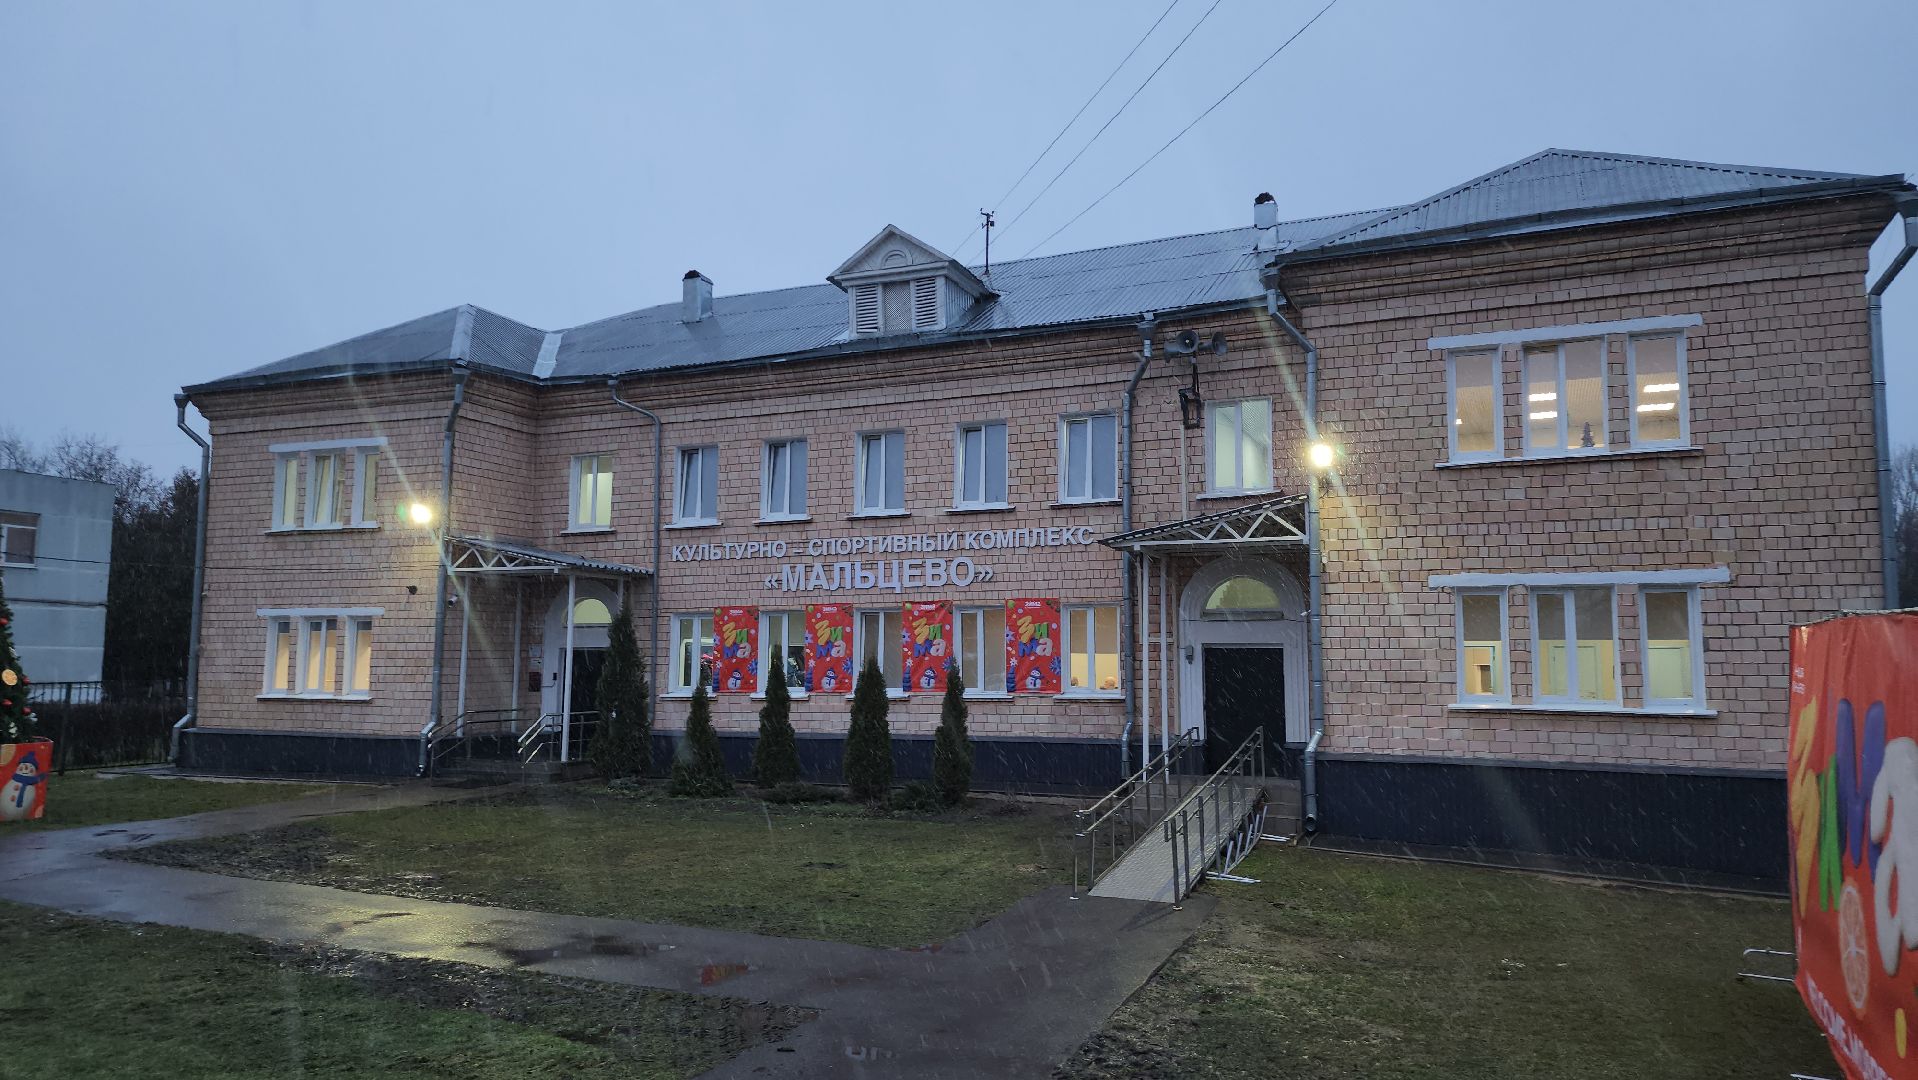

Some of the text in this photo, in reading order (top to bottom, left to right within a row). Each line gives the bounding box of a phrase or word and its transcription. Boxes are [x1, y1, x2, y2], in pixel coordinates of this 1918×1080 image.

[671, 540, 788, 562] КУЛЬТУРНО
[808, 527, 960, 557] СПОРТИВНЫЙ
[965, 526, 1095, 550] КОМПЛЕКС
[764, 556, 994, 593] «МАЛЬЦЕВО»
